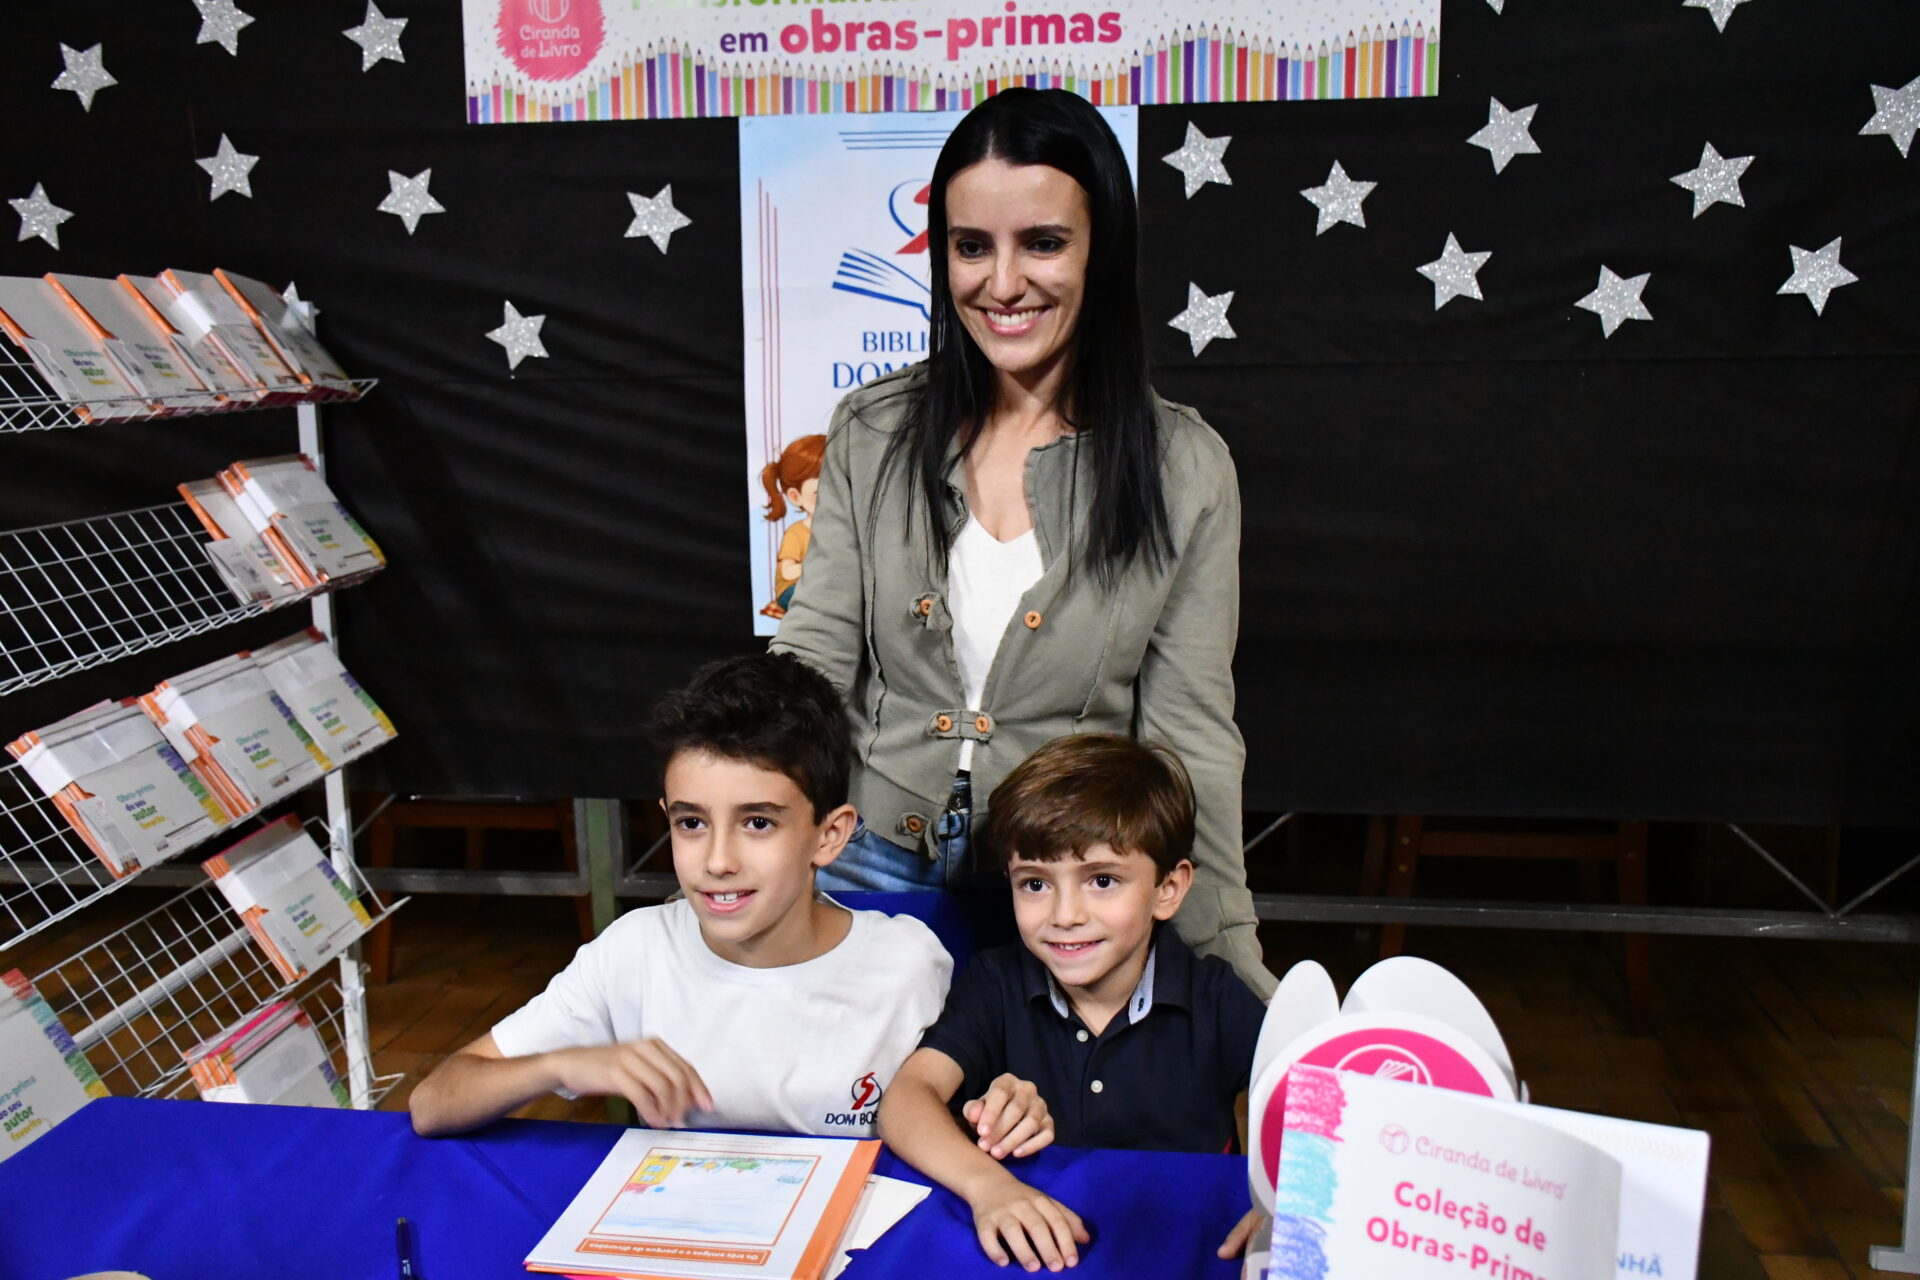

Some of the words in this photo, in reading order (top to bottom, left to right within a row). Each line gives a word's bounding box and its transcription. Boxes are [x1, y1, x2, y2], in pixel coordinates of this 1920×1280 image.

[520, 24, 581, 41] Ciranda
[720, 31, 768, 53] em
[780, 1, 1122, 61] obras-primas
[521, 46, 536, 58] de
[539, 41, 581, 58] Livro
[863, 331, 926, 352] BIBLI
[833, 361, 908, 388] DO
[132, 805, 157, 821] autor
[3, 1105, 34, 1132] autor
[8, 1099, 23, 1113] seu
[824, 1112, 857, 1127] DOM
[1415, 1136, 1490, 1173] Ciranda
[1495, 1161, 1518, 1183] de
[1522, 1168, 1567, 1200] Livro
[1394, 1181, 1507, 1236] Coleção
[1515, 1218, 1547, 1251] de
[1366, 1216, 1547, 1280] Obras-Prim
[1616, 1252, 1662, 1277] NHÃ
